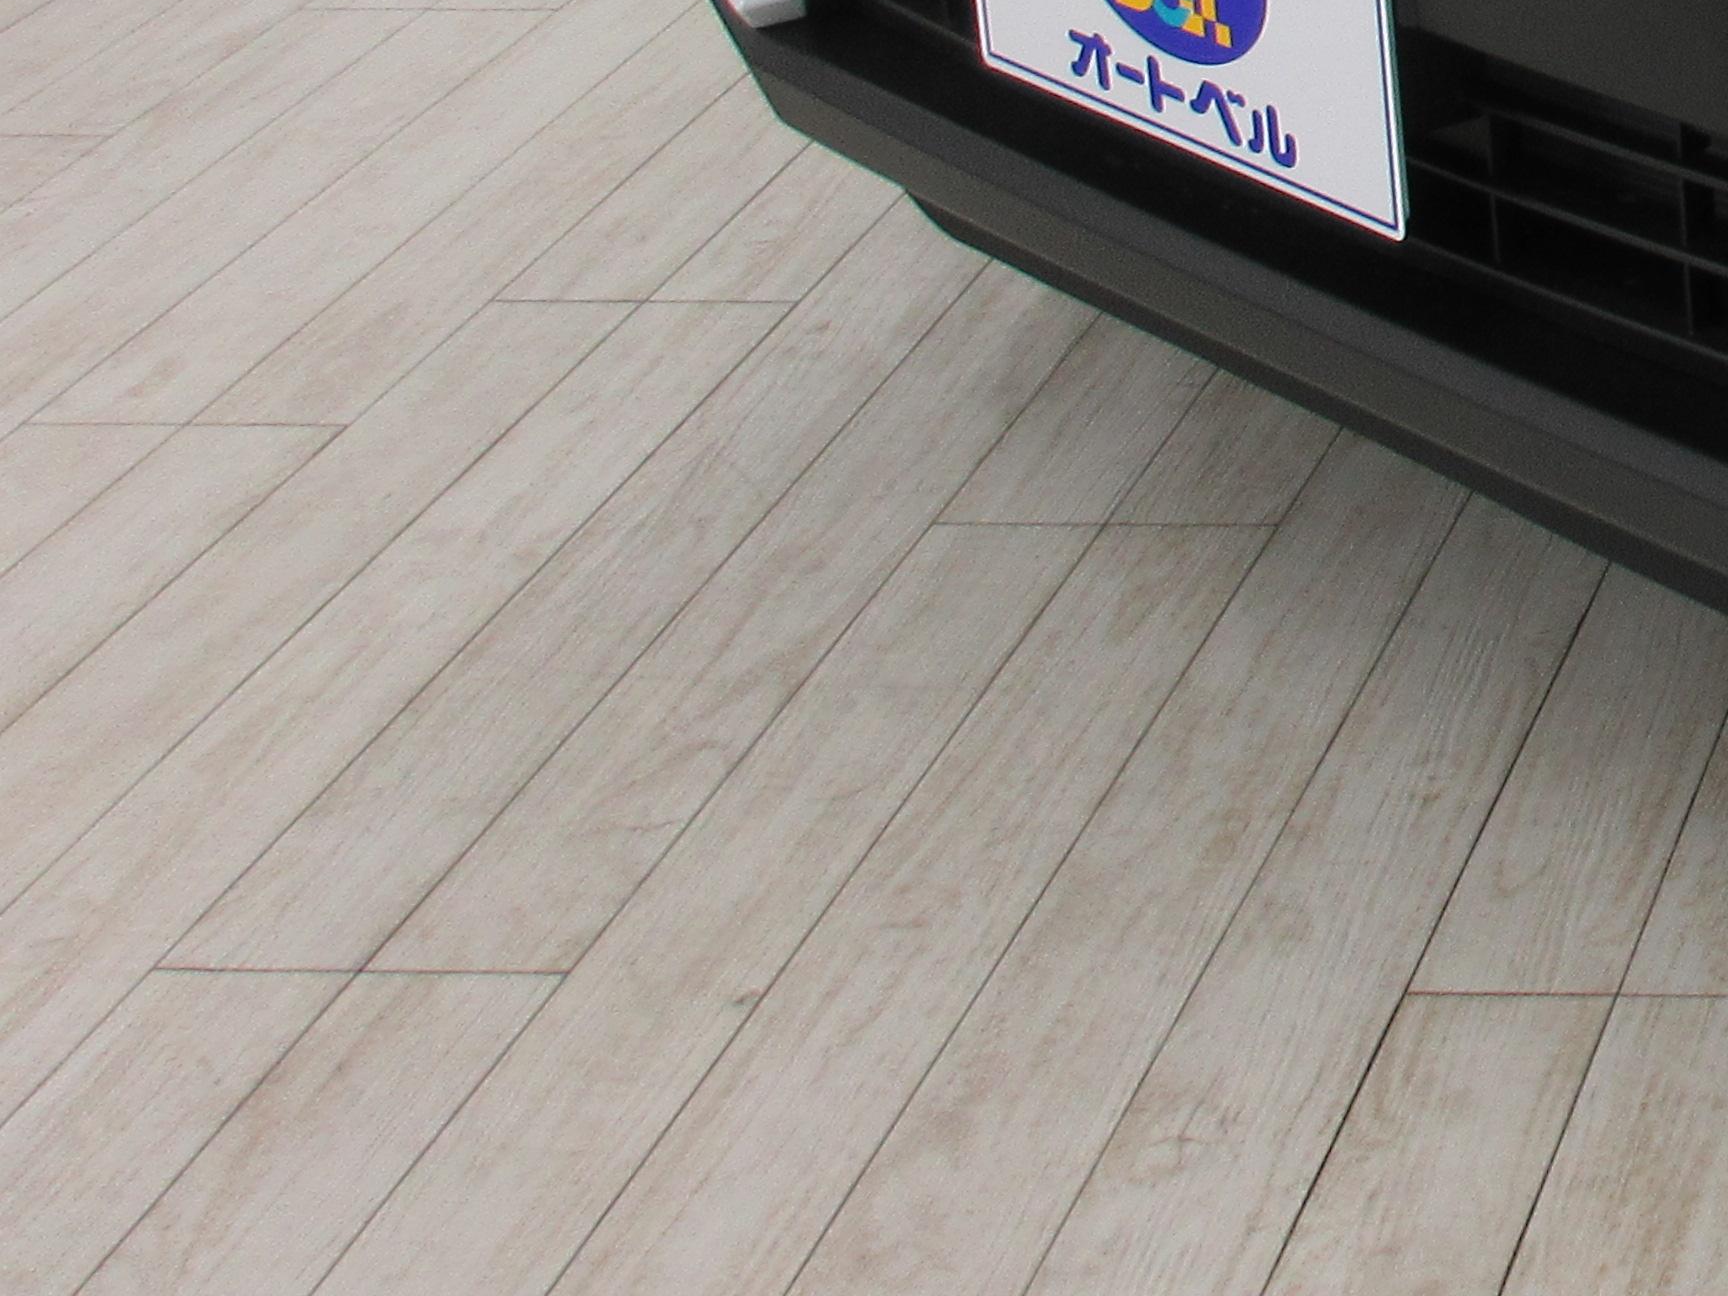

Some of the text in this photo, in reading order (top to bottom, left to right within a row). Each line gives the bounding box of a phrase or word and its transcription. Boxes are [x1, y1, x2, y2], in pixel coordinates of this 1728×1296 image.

[1068, 27, 1299, 169] オートベル
